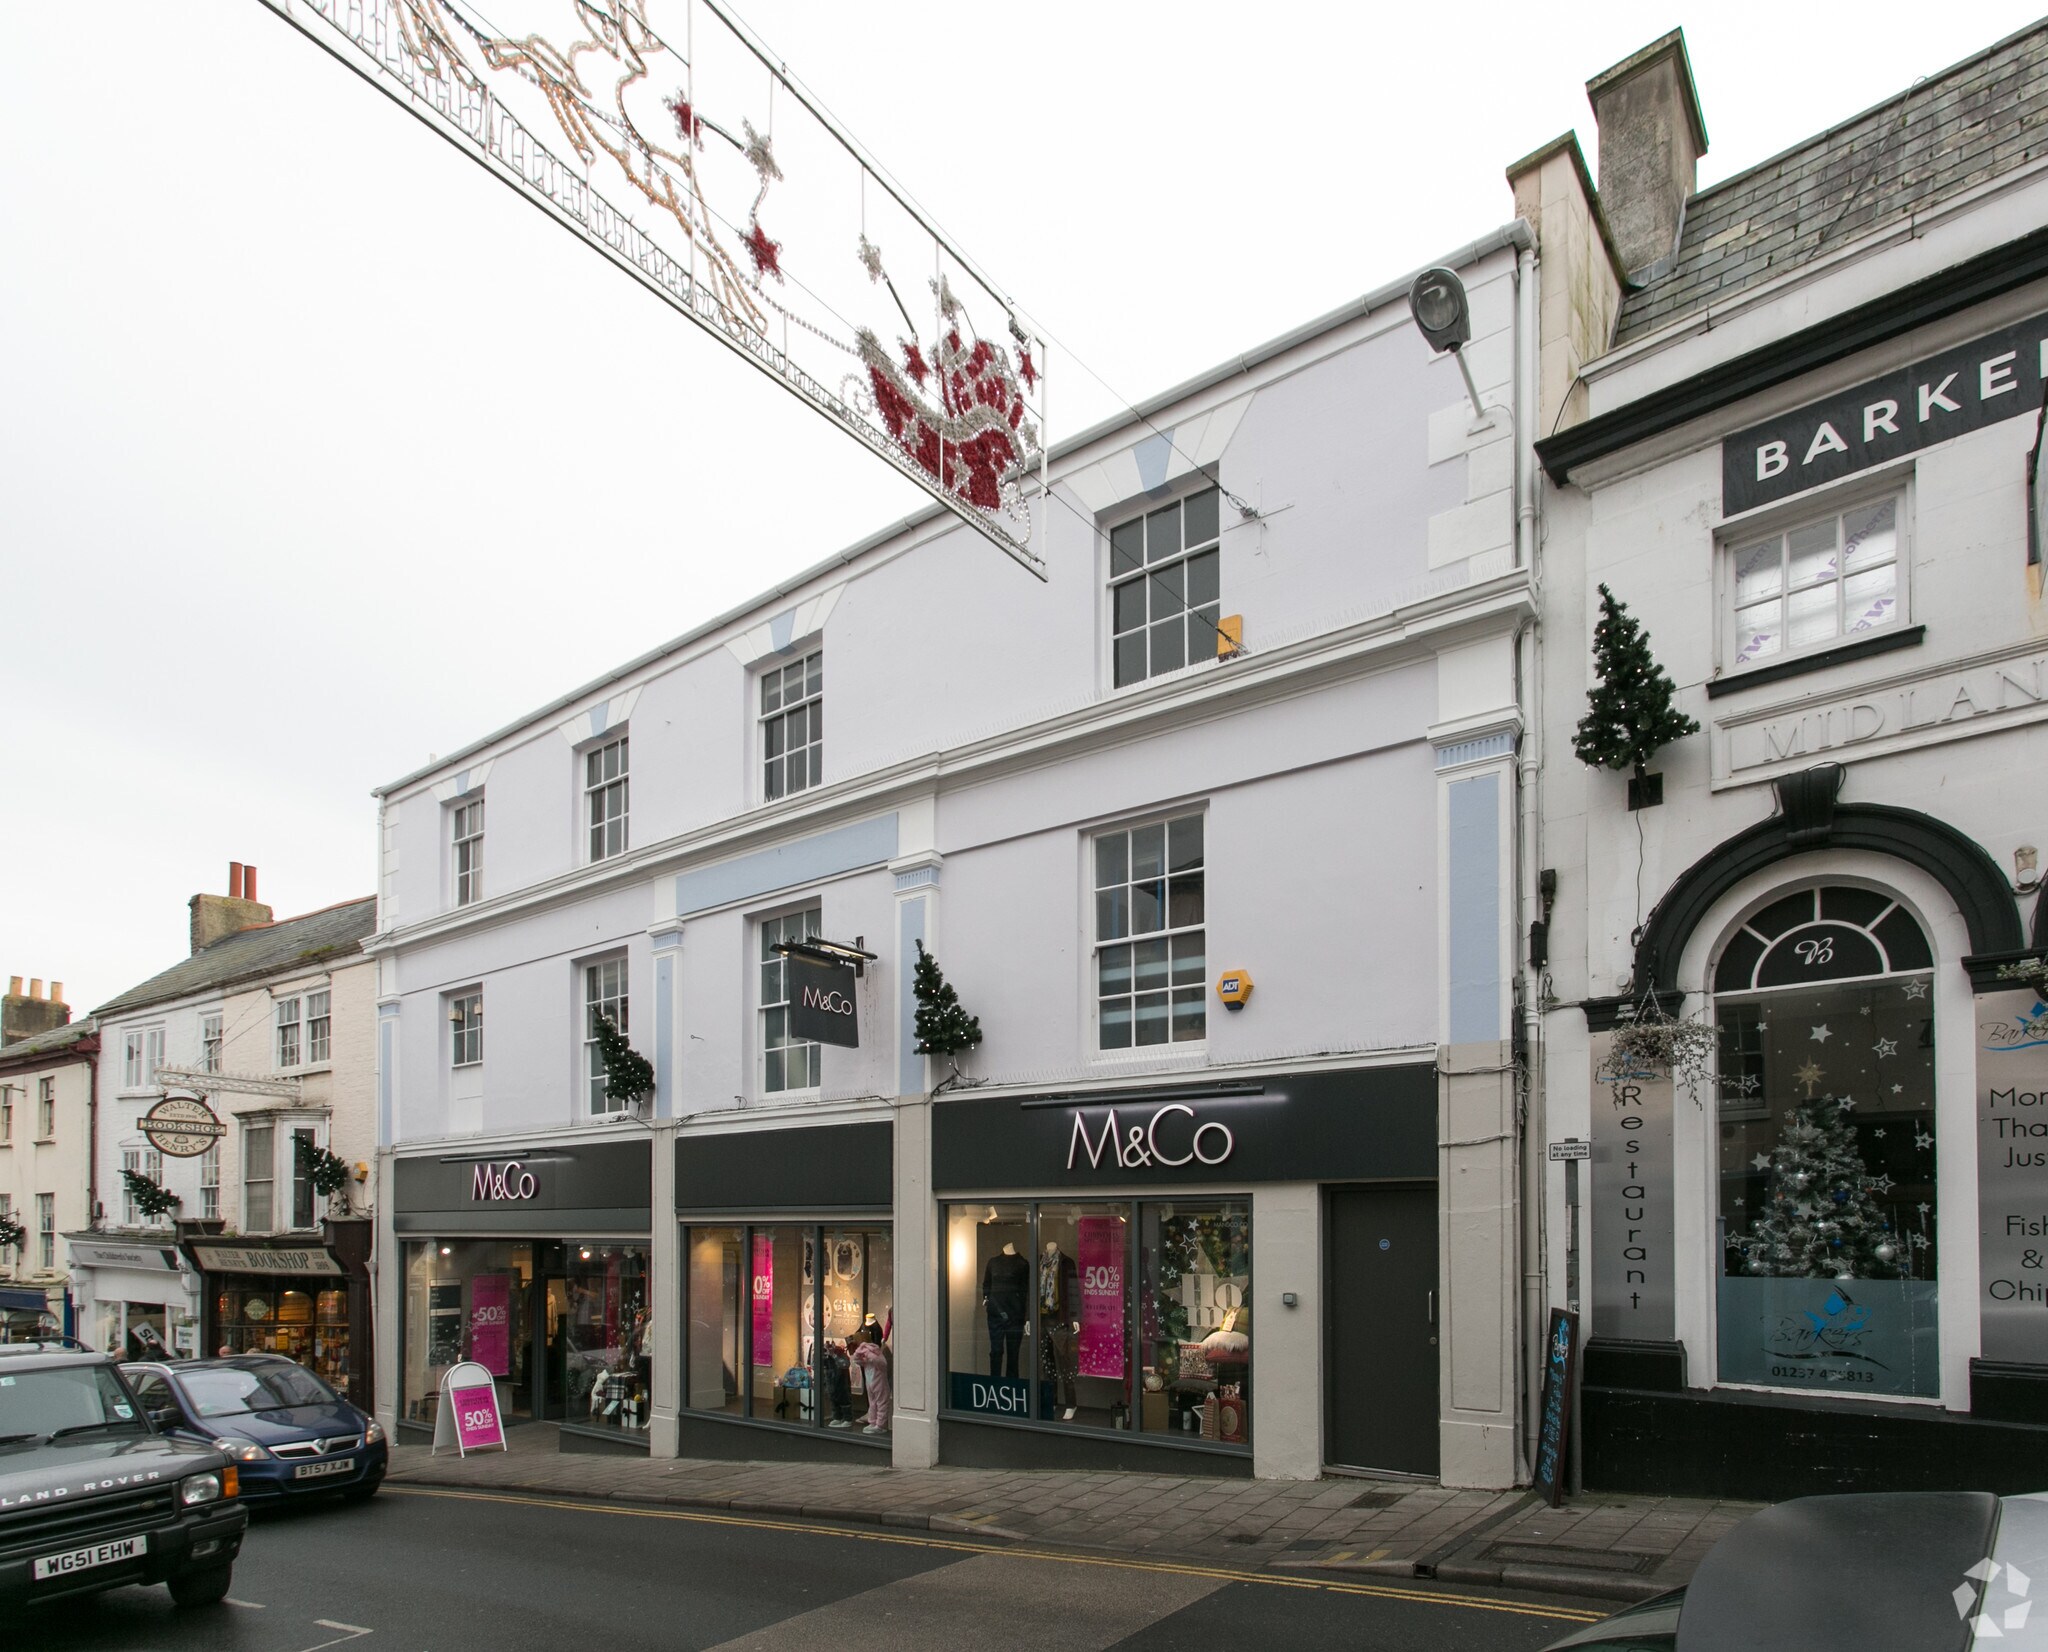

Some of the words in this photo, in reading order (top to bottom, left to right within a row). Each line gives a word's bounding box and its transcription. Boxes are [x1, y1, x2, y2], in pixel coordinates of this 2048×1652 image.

[1756, 338, 2048, 482] BARKE
[1828, 500, 1894, 568] EoTherm
[1223, 981, 1239, 992] ADT
[803, 985, 852, 1015] M&Co
[159, 1101, 207, 1119] WALTER
[146, 1120, 222, 1135] BOOKSHOP
[1067, 1104, 1234, 1169] M&Co
[155, 1133, 207, 1153] HENRY'S
[2003, 1146, 2048, 1168] Jus
[472, 1161, 537, 1200] M&Co
[1620, 1085, 1646, 1310] Restaurant
[246, 1252, 309, 1269] BOOKSHOP
[2021, 1249, 2044, 1269] &
[753, 1275, 770, 1295] 0%
[1084, 1266, 1120, 1289] 50%
[1098, 1289, 1120, 1297] SUNDAY
[477, 1305, 506, 1321] 50%
[1772, 1366, 1815, 1379] 01237
[973, 1383, 1027, 1412] DASH
[465, 1408, 493, 1427] 50%
[2, 1487, 68, 1507] LAND
[84, 1471, 160, 1492] ROVER
[47, 1551, 93, 1575] WG51
[98, 1540, 134, 1562] EHW
